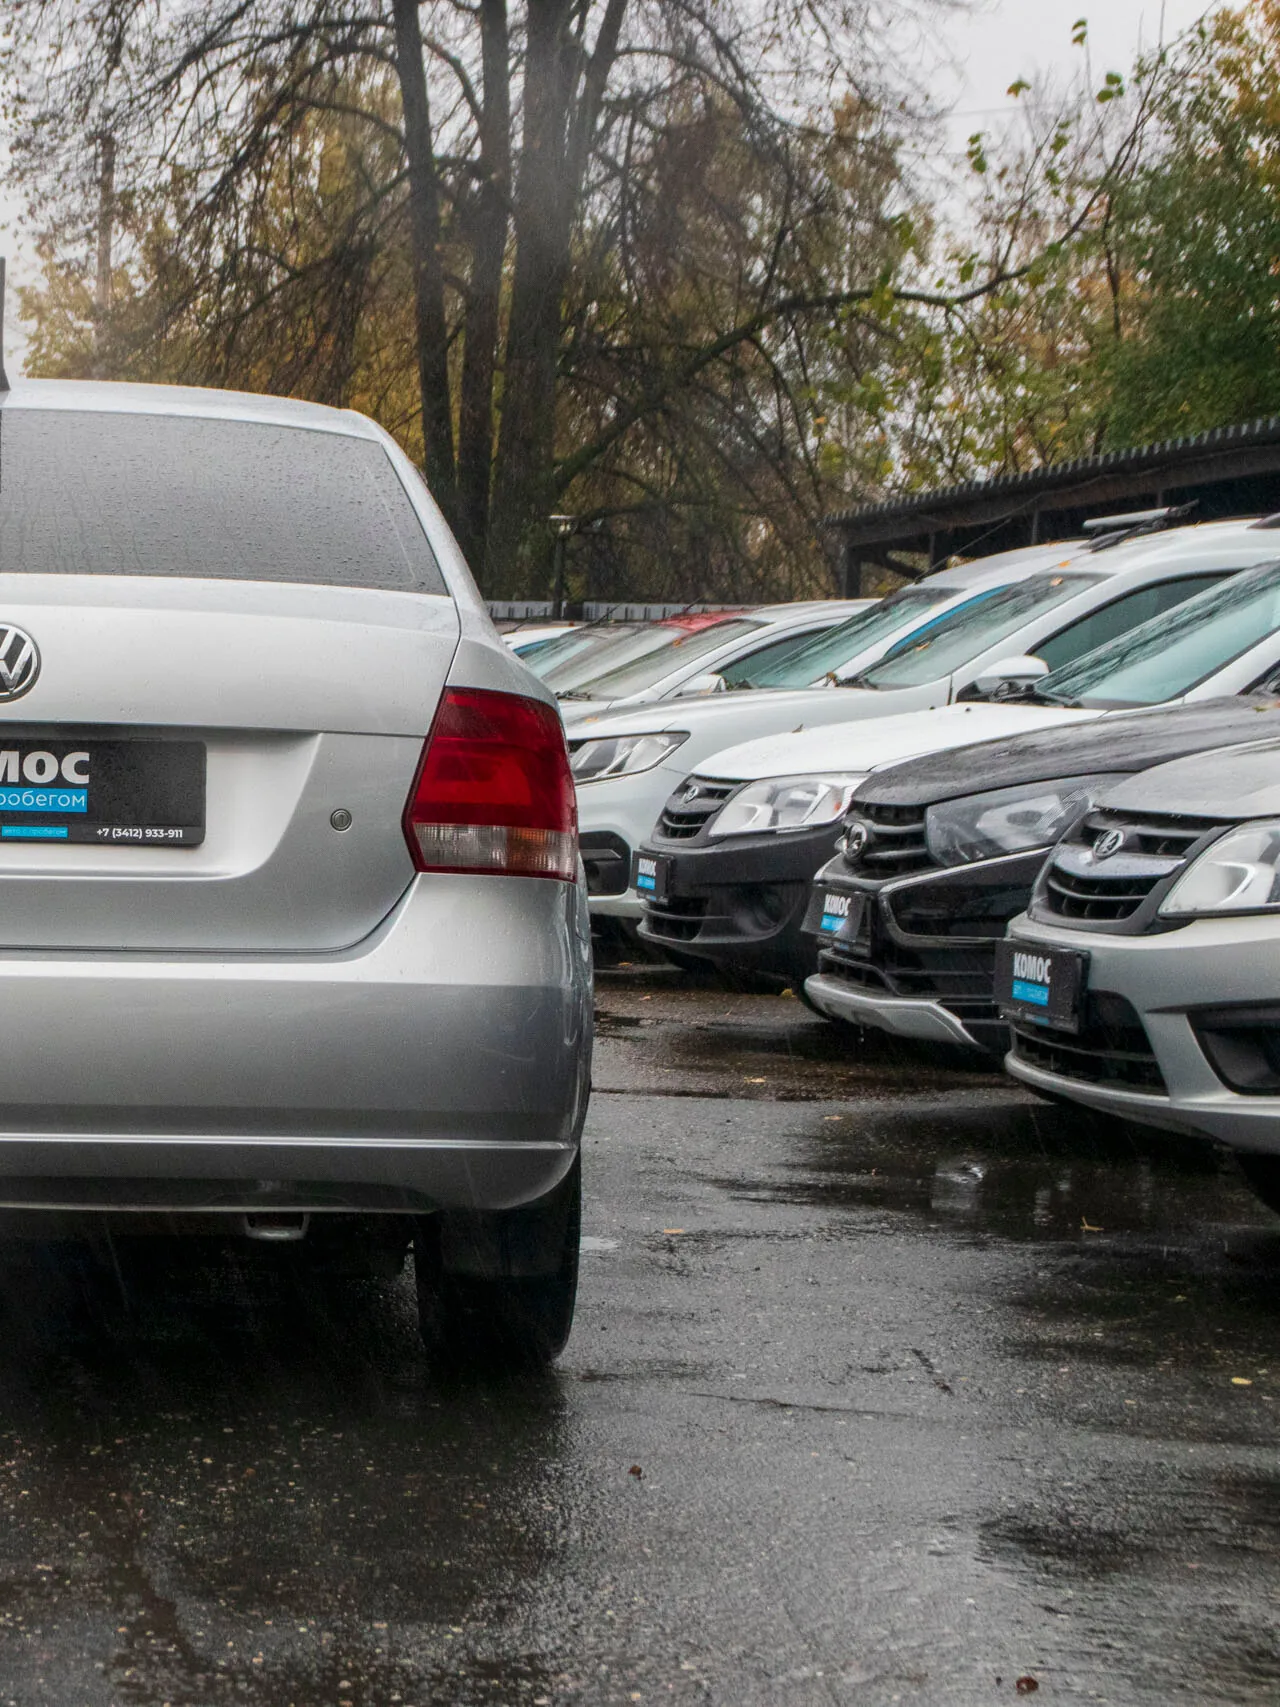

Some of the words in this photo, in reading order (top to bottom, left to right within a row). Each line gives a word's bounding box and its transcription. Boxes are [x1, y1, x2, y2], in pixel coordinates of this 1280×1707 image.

[96, 828, 110, 837] +7
[112, 828, 142, 839] (3412)
[145, 829, 183, 838] 933-911
[1013, 952, 1052, 985] КОМОС
